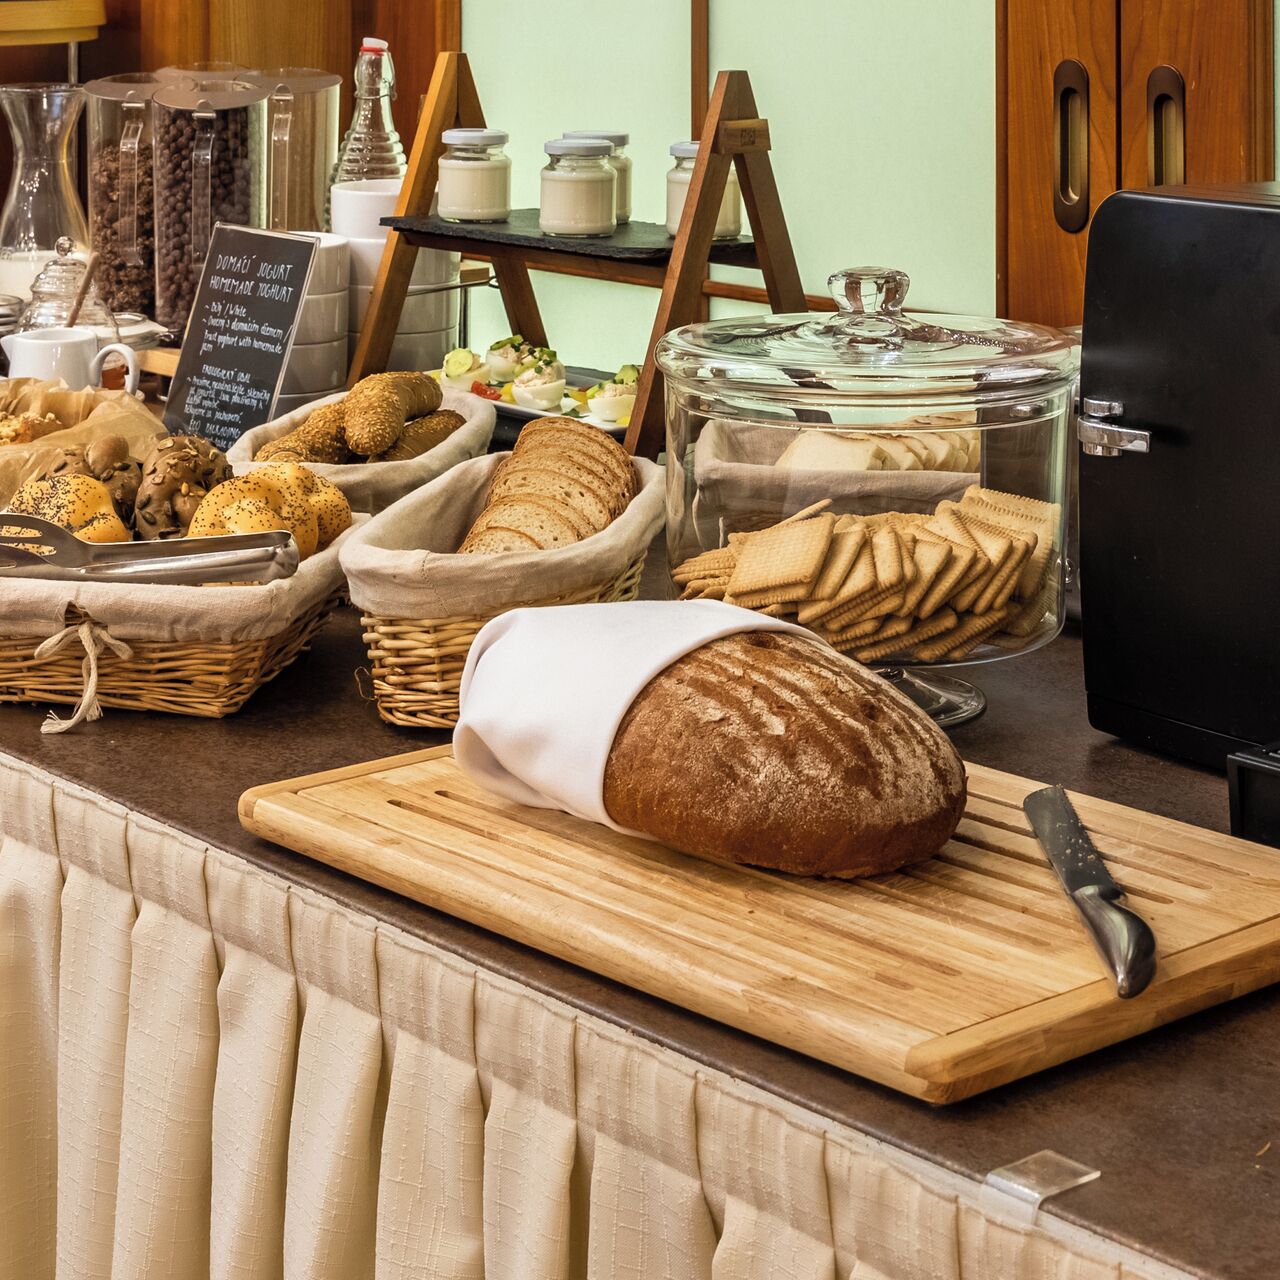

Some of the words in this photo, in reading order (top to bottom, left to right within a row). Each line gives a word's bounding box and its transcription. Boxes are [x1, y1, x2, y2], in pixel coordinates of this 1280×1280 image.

[256, 262, 294, 282] JOGURT
[209, 274, 255, 296] HOMEMADE
[256, 282, 294, 303] YOGHURT
